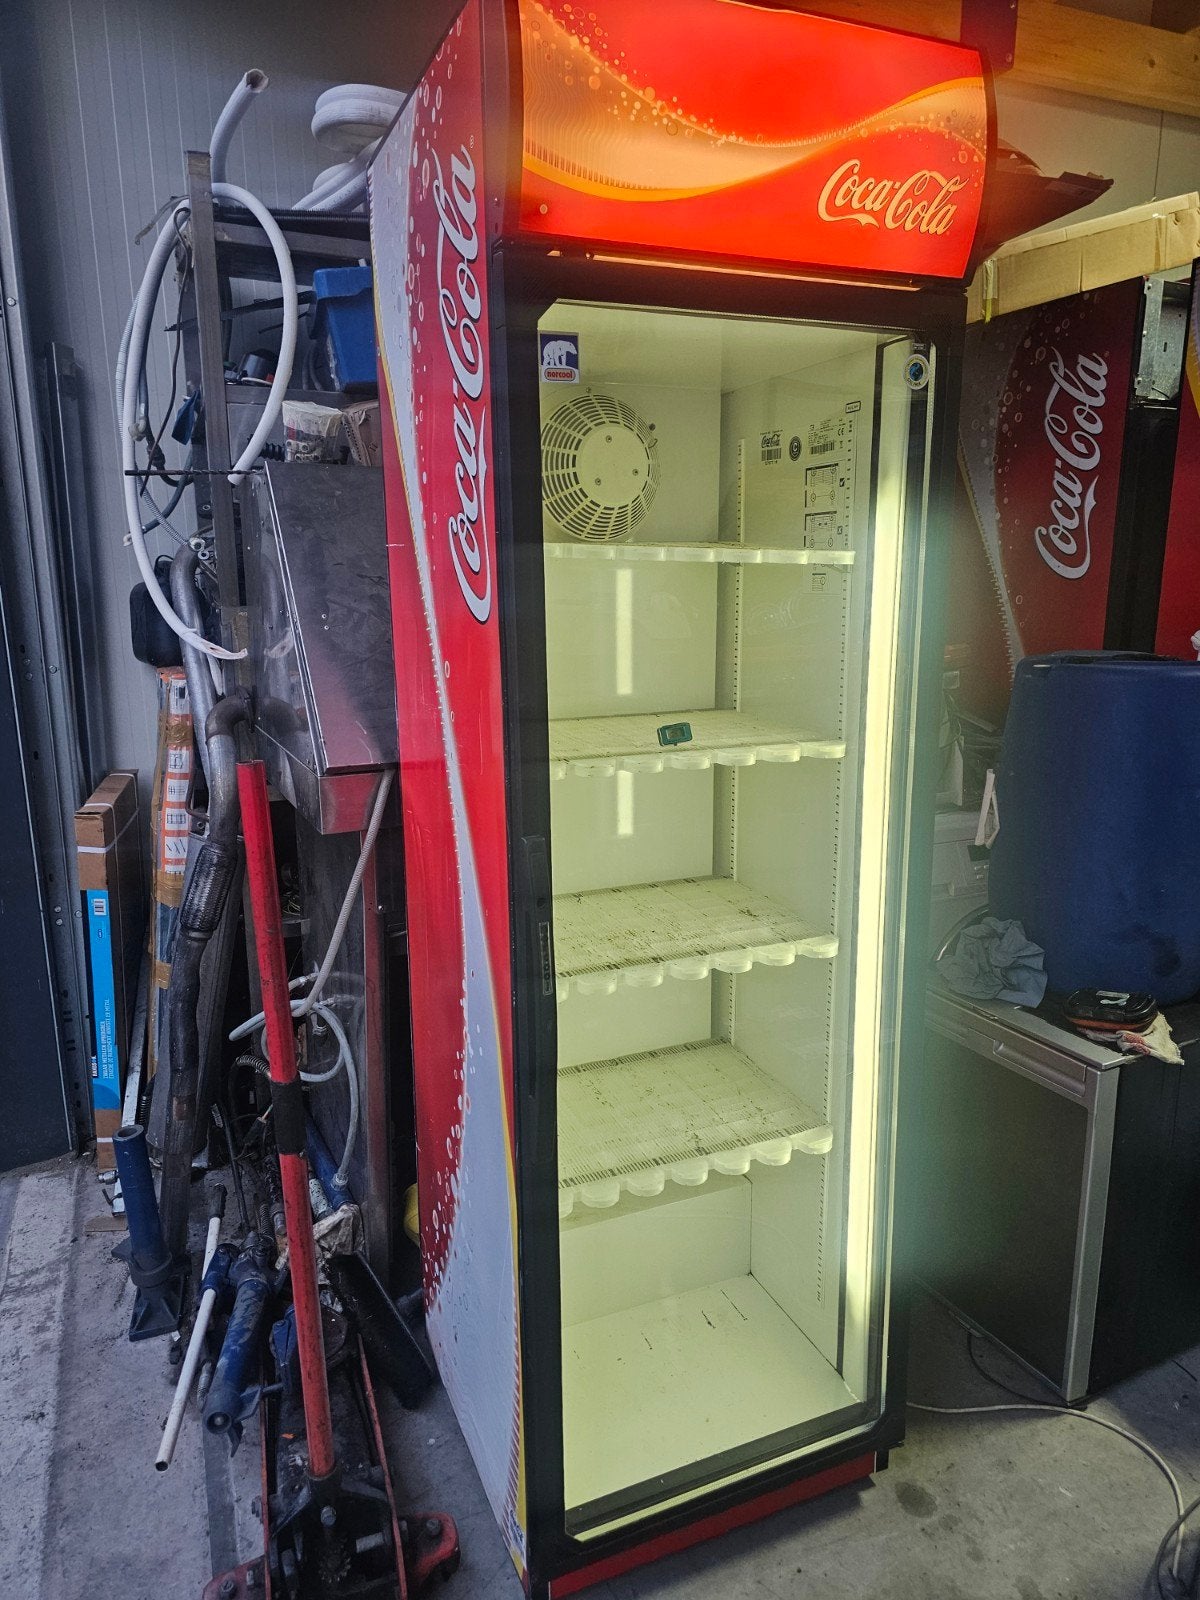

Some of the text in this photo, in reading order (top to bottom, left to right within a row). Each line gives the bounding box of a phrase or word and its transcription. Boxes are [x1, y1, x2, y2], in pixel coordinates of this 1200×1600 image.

[816, 158, 970, 236] Coca-Cola
[431, 143, 492, 624] Coca-Cola
[546, 371, 573, 379] norcool
[1034, 345, 1108, 580] Coca-Cola
